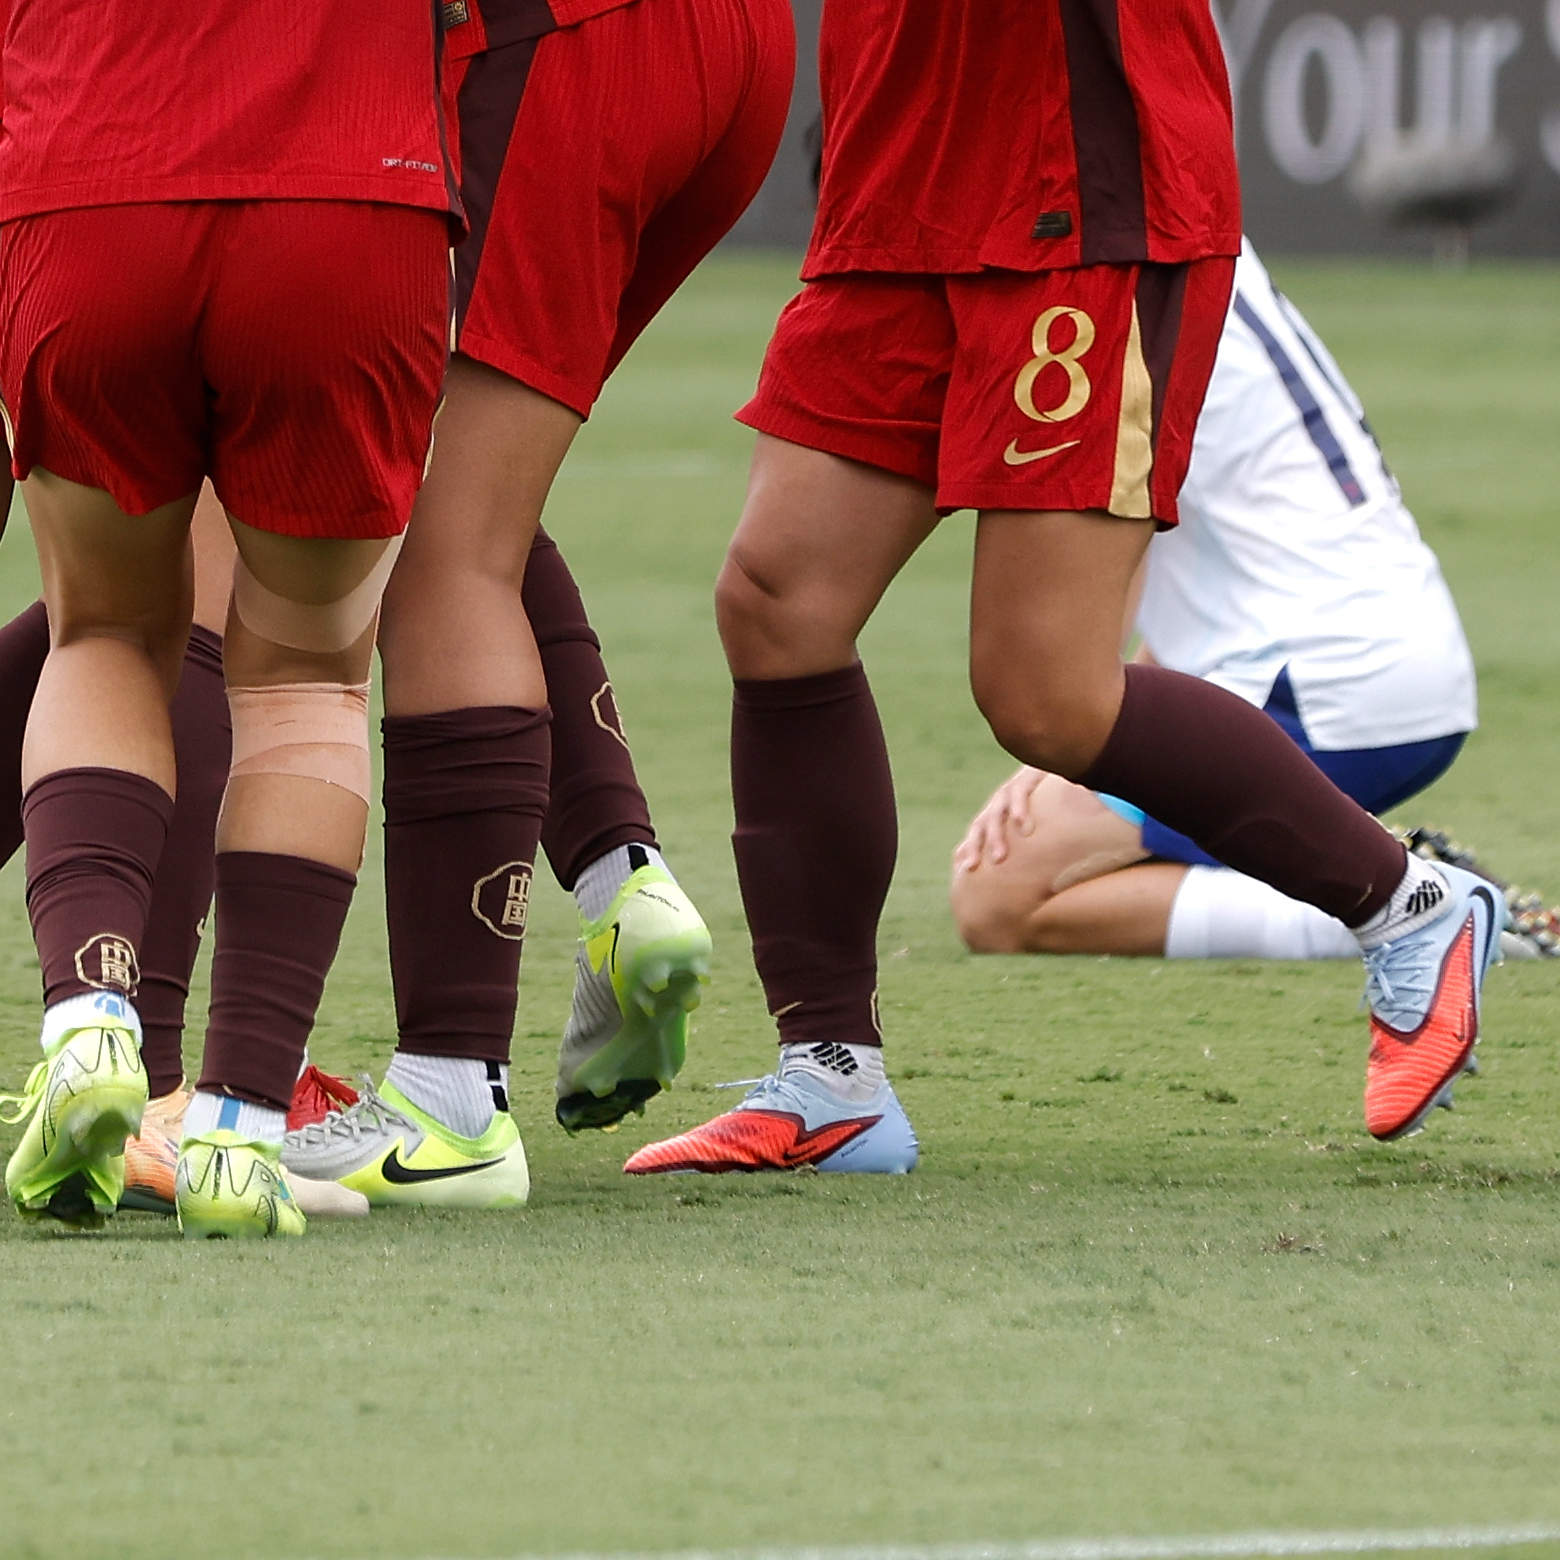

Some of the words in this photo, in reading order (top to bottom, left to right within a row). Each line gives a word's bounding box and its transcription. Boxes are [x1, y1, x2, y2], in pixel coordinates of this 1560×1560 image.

[1013, 305, 1096, 424] 8
[500, 871, 532, 928] 中国
[100, 941, 132, 992] 中国
